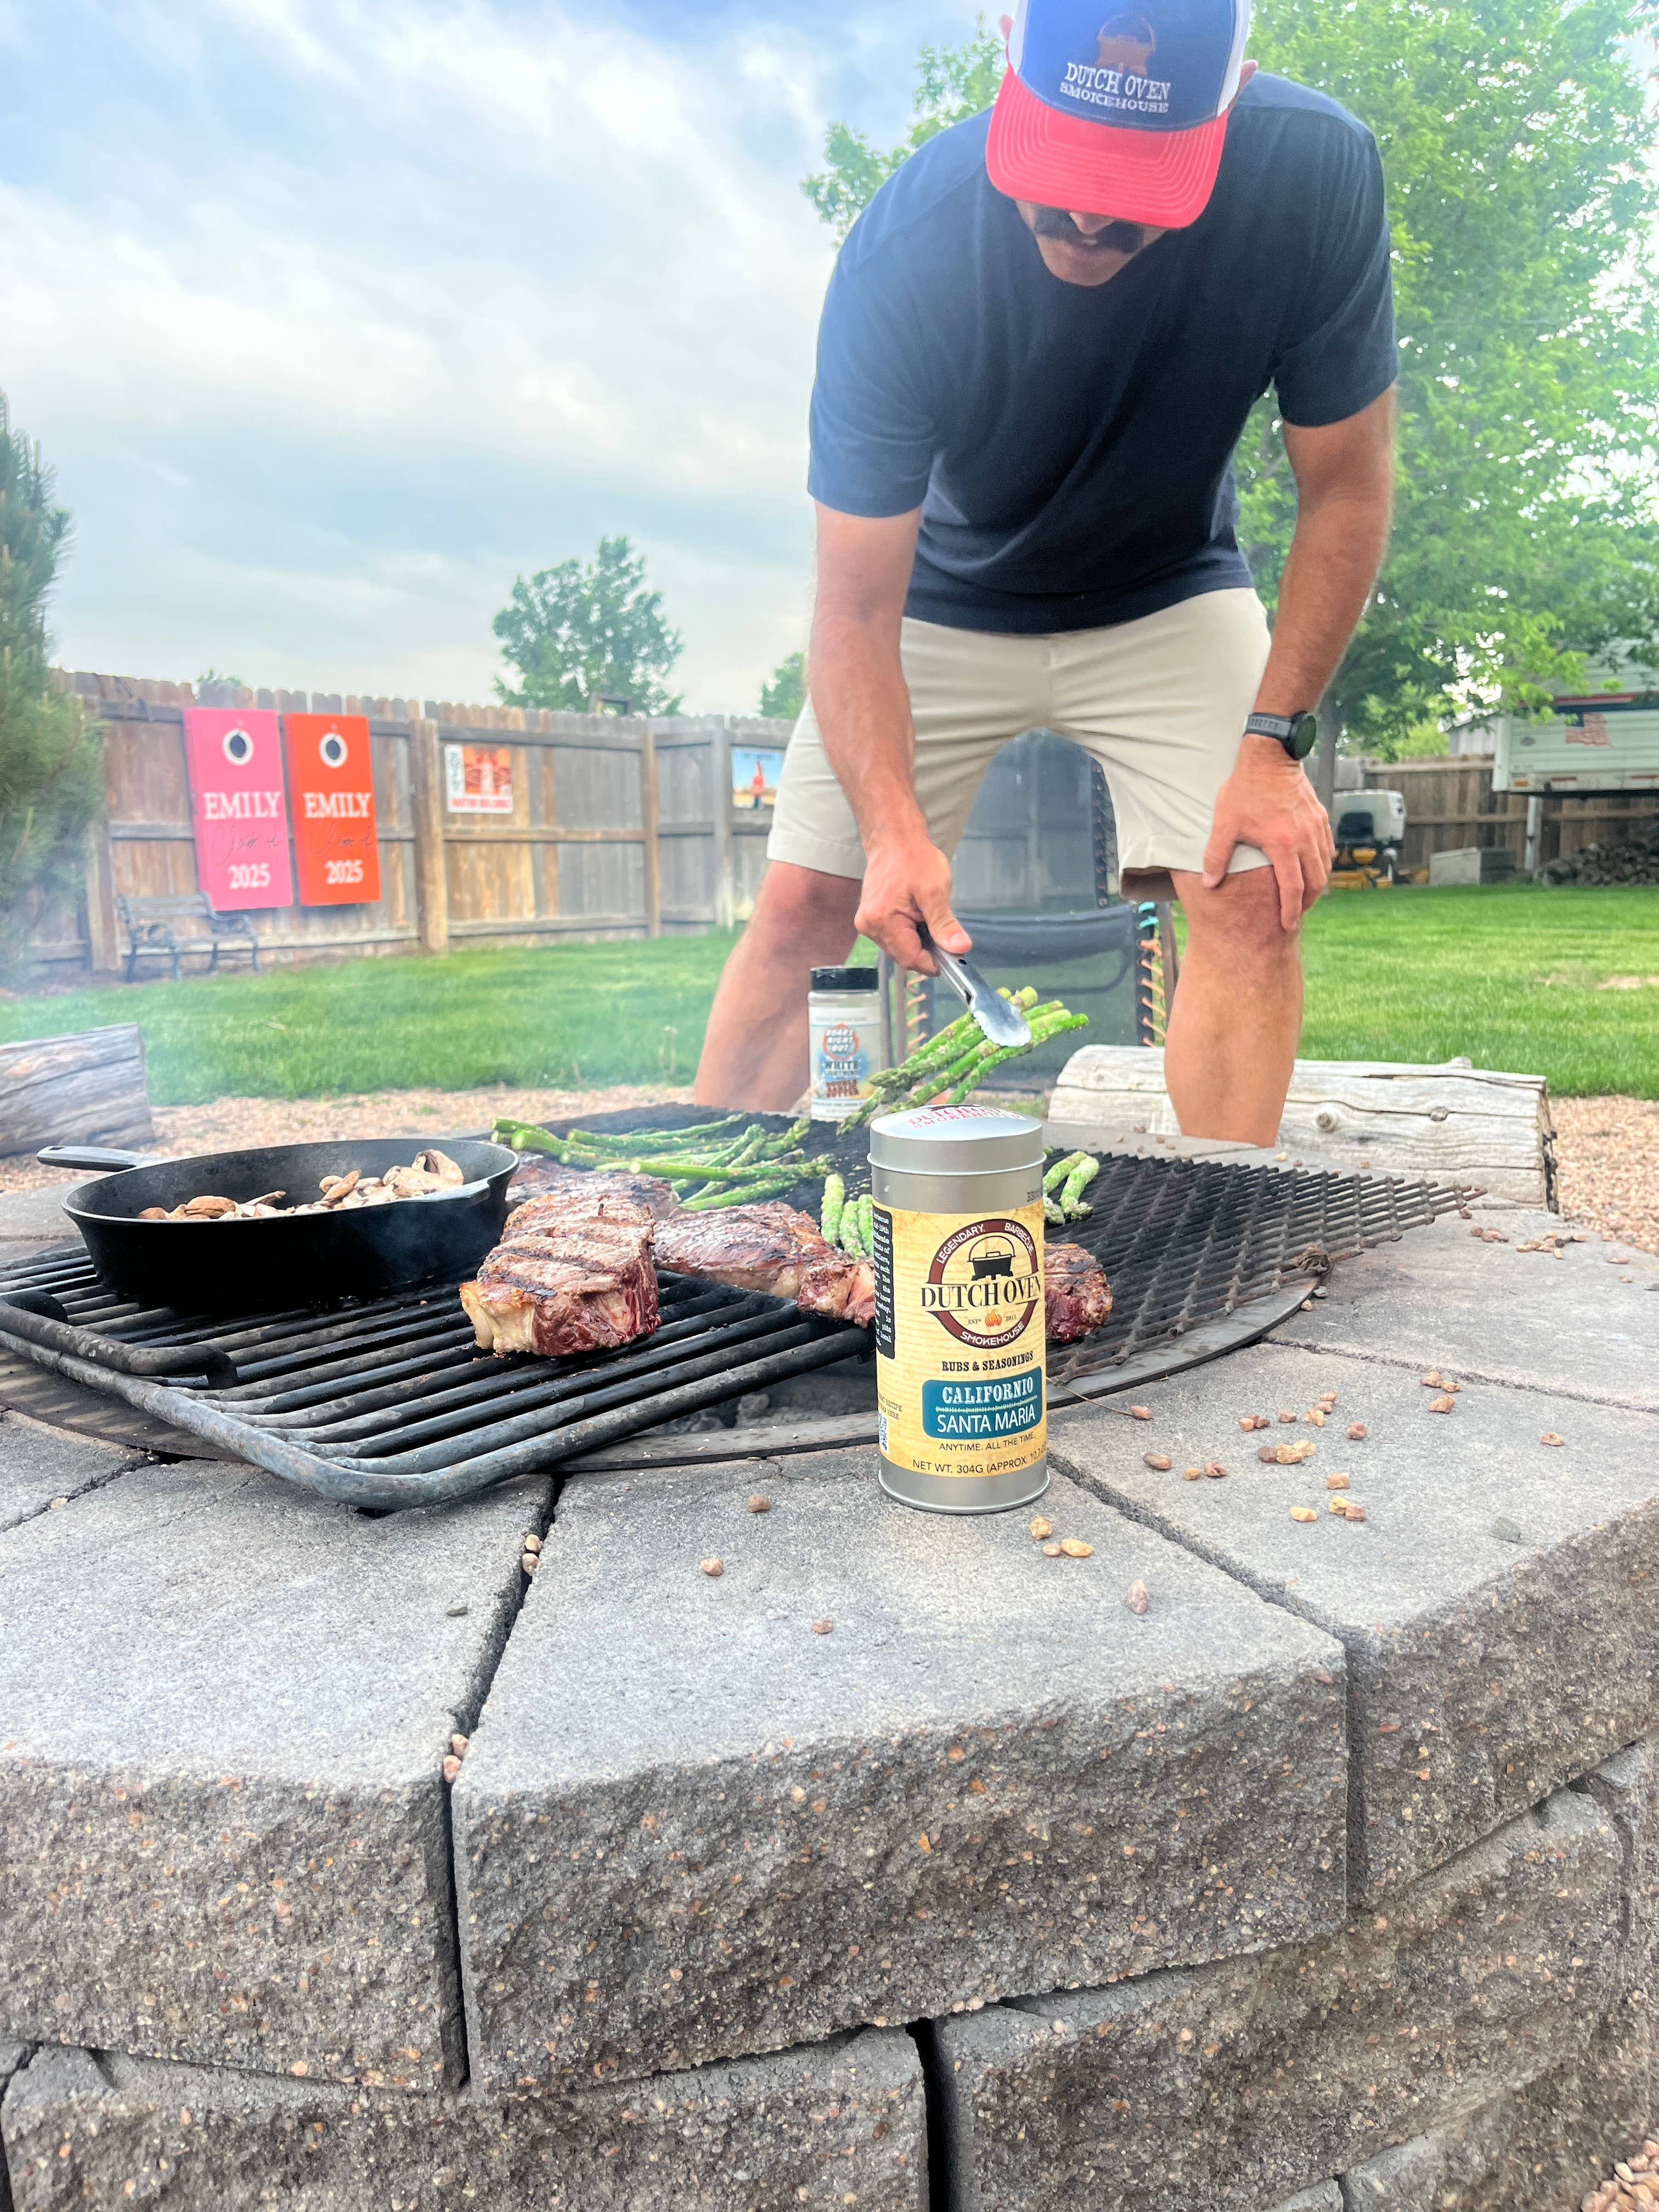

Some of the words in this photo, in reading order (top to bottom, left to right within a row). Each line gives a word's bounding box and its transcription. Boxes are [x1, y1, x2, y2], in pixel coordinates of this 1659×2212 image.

[1064, 62, 1124, 94] DUTCH
[1125, 75, 1171, 100] OVEN
[1059, 82, 1169, 113] SMOKEHOUSE
[202, 790, 281, 820] EMILY
[302, 791, 372, 819] EMILY
[228, 862, 271, 889] 2025
[325, 860, 364, 885] 2025
[831, 1044, 849, 1052] OUT
[824, 1061, 858, 1070] WHITE
[908, 1108, 970, 1125] DUTCH
[921, 1282, 1000, 1308] DUTCH
[1003, 1274, 1041, 1304] OVEN
[960, 1321, 1025, 1346] SMOKEHOUSE
[941, 1361, 969, 1372] RUBS
[972, 1361, 980, 1371] &
[982, 1351, 1034, 1371] SEASONINGS
[942, 1376, 1034, 1404] CALIFORNIO
[937, 1414, 992, 1434] SANTA
[995, 1403, 1036, 1431] MARIA
[939, 1442, 983, 1452] ANYTIME.
[985, 1442, 1001, 1450] ALL
[1002, 1438, 1018, 1448] THE
[1019, 1431, 1034, 1443] TIME
[912, 1459, 932, 1471] NET
[934, 1463, 953, 1474] WT.
[956, 1464, 984, 1474] 304G
[986, 1458, 1028, 1474] (APPROX.
